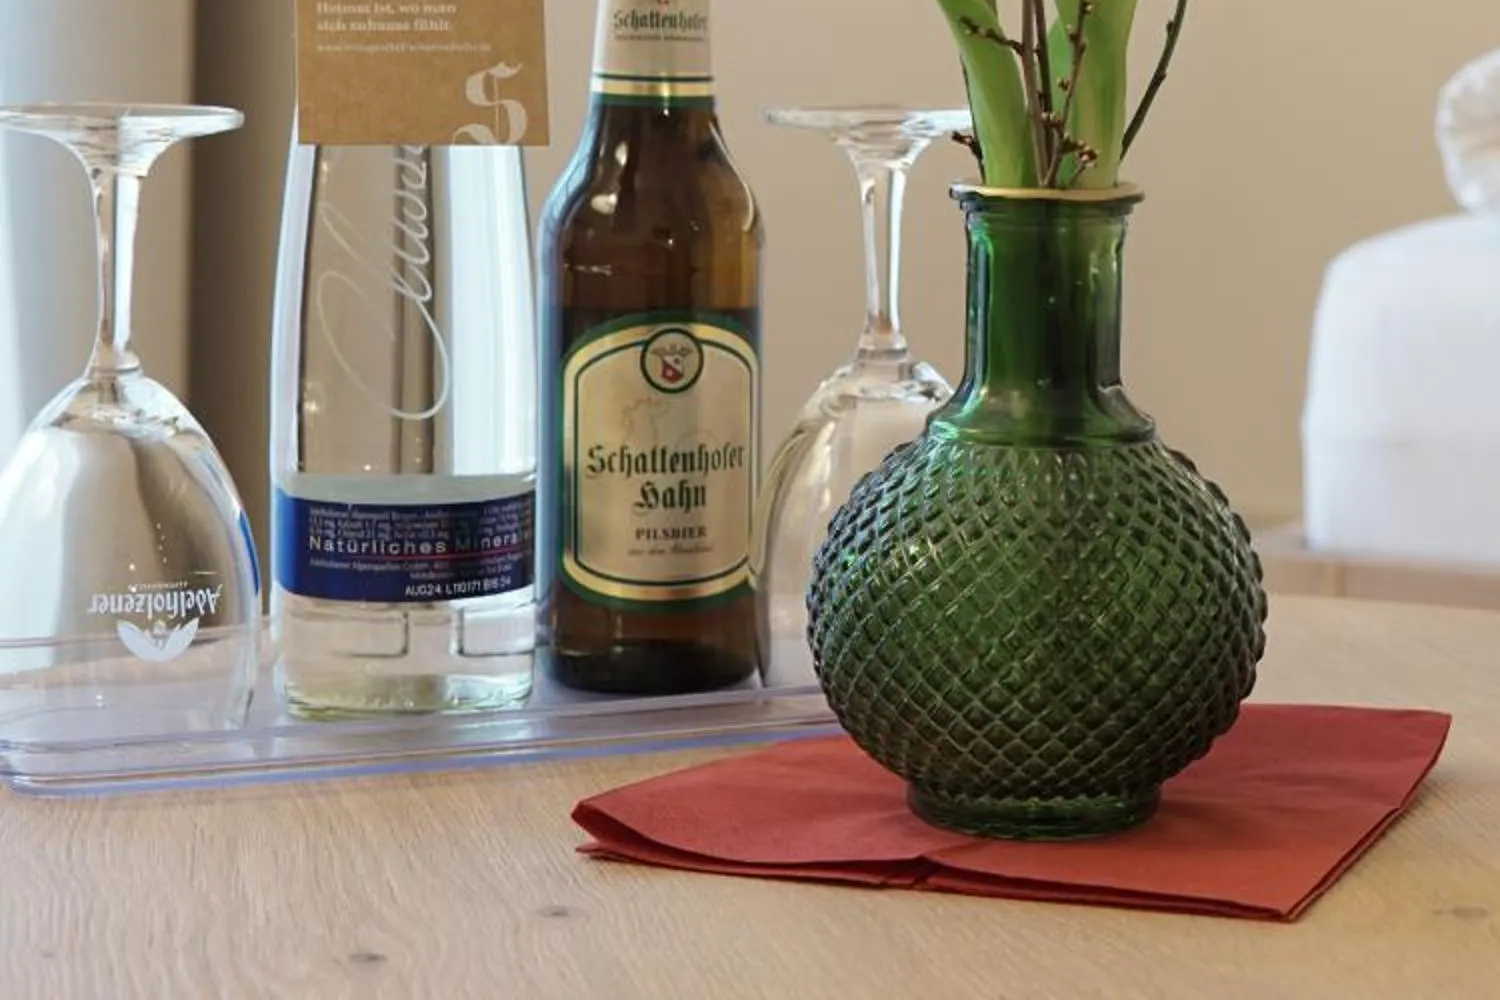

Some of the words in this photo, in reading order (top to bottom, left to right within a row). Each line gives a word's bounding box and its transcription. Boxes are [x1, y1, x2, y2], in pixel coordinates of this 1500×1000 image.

[587, 443, 745, 478] Schattenhofer
[633, 479, 707, 513] Hahn
[309, 535, 447, 555] Natürliches
[87, 584, 223, 619] Adelholzener
